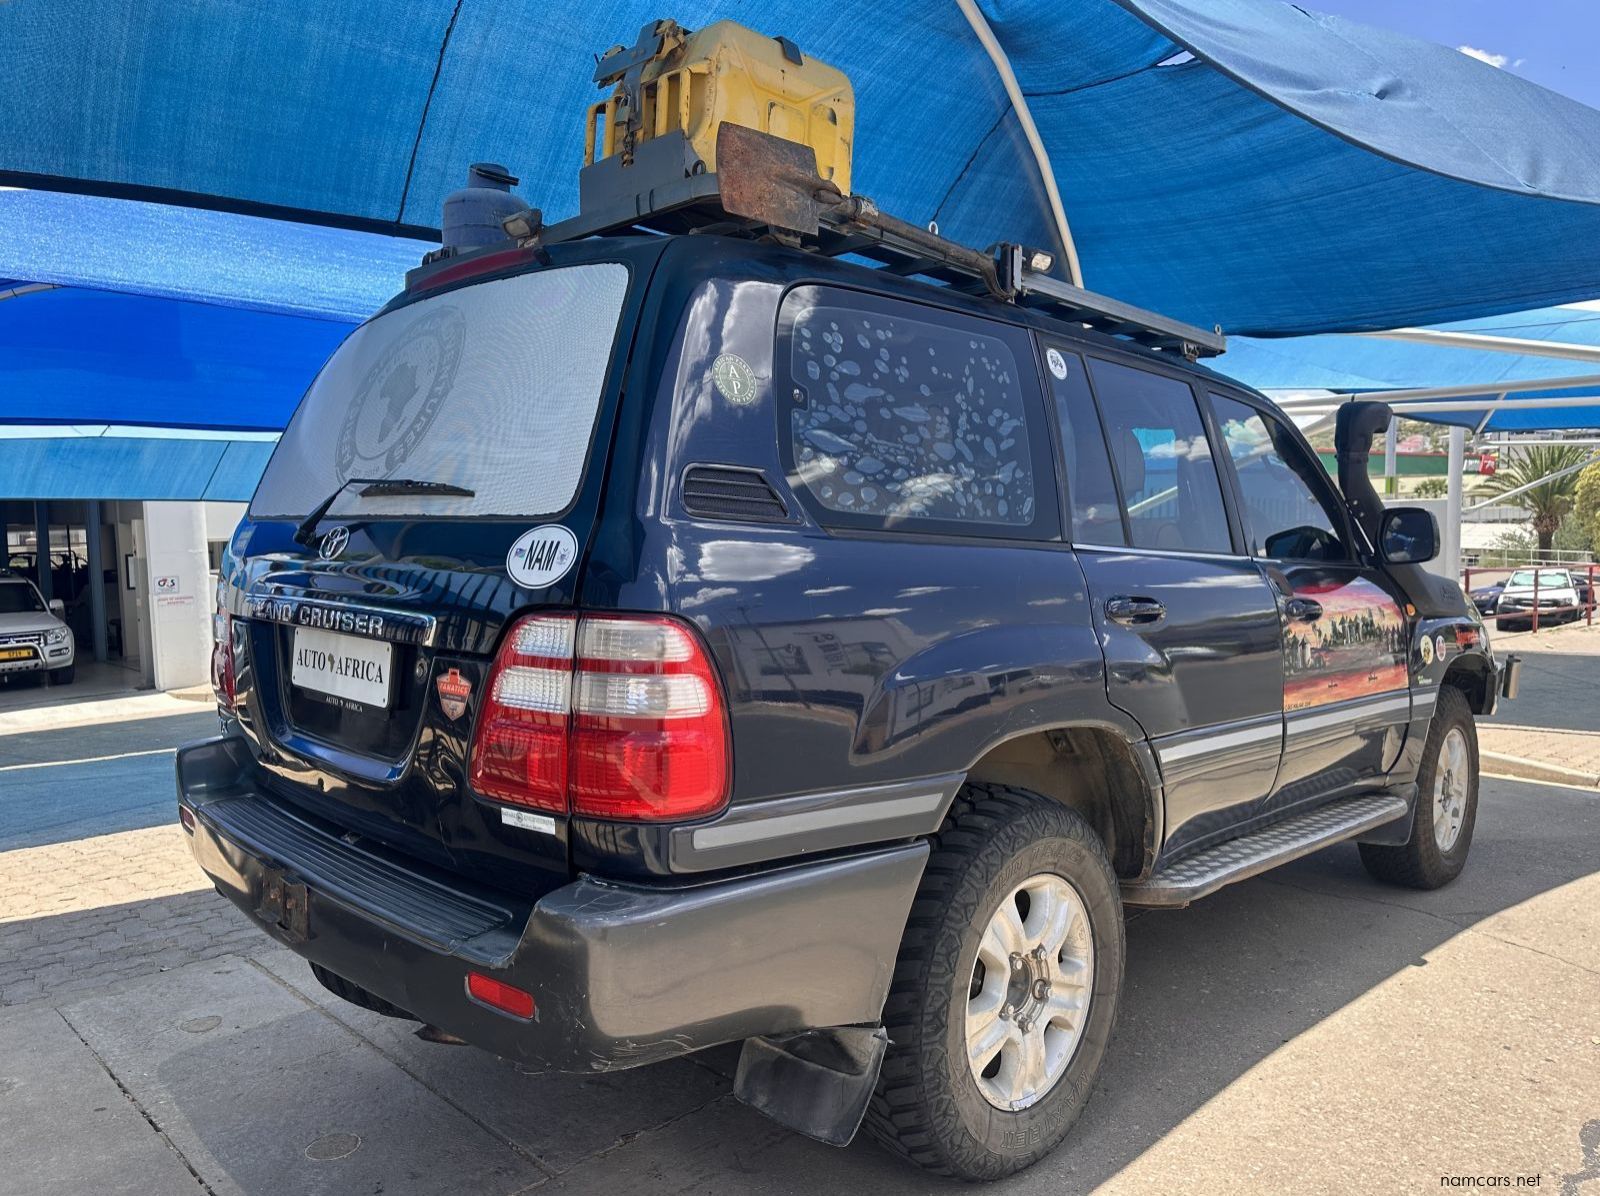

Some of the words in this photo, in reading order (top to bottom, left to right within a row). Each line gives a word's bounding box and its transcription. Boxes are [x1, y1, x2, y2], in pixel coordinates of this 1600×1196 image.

[522, 540, 560, 571] NAM
[300, 605, 384, 636] CRUISER
[296, 647, 327, 672] AUTO
[335, 656, 384, 684] AFRICA
[326, 695, 339, 706] AUTO
[345, 700, 363, 713] AFRICA
